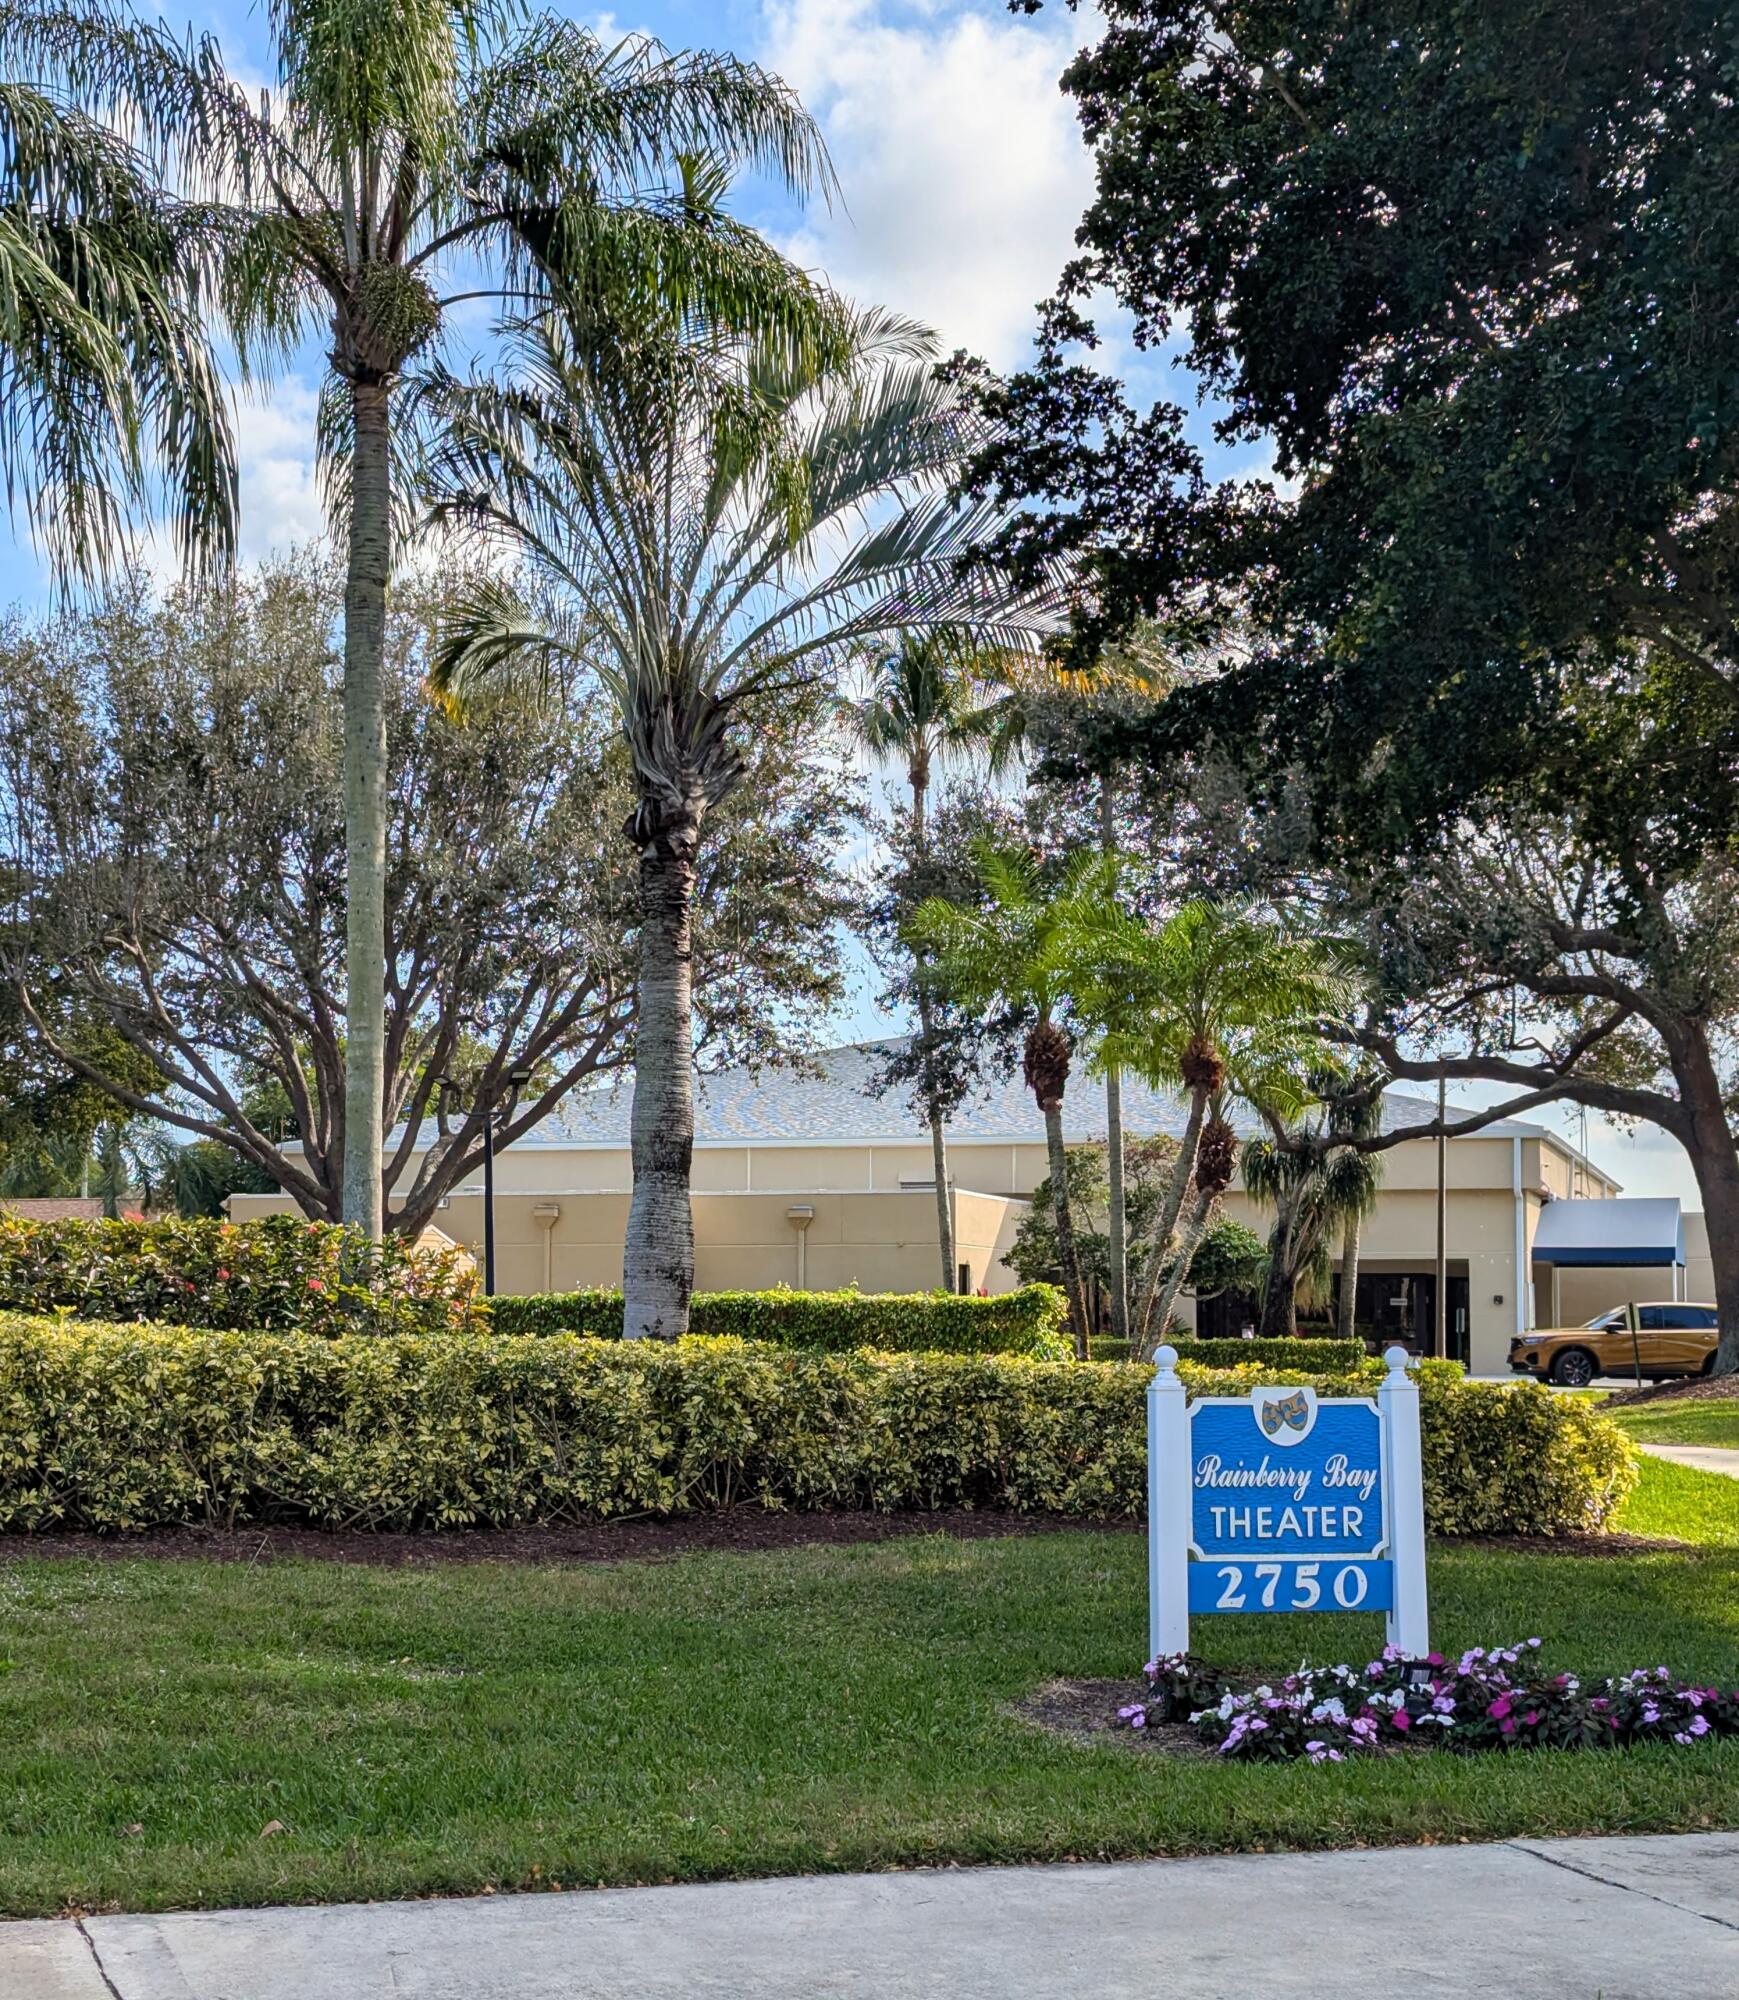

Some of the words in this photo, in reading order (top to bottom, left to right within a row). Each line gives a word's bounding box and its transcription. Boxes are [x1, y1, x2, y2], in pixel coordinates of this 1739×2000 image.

[1195, 1455, 1312, 1501] Rainberry
[1322, 1454, 1377, 1500] Bay
[1211, 1507, 1363, 1538] THEATER
[1216, 1563, 1368, 1609] 2750
